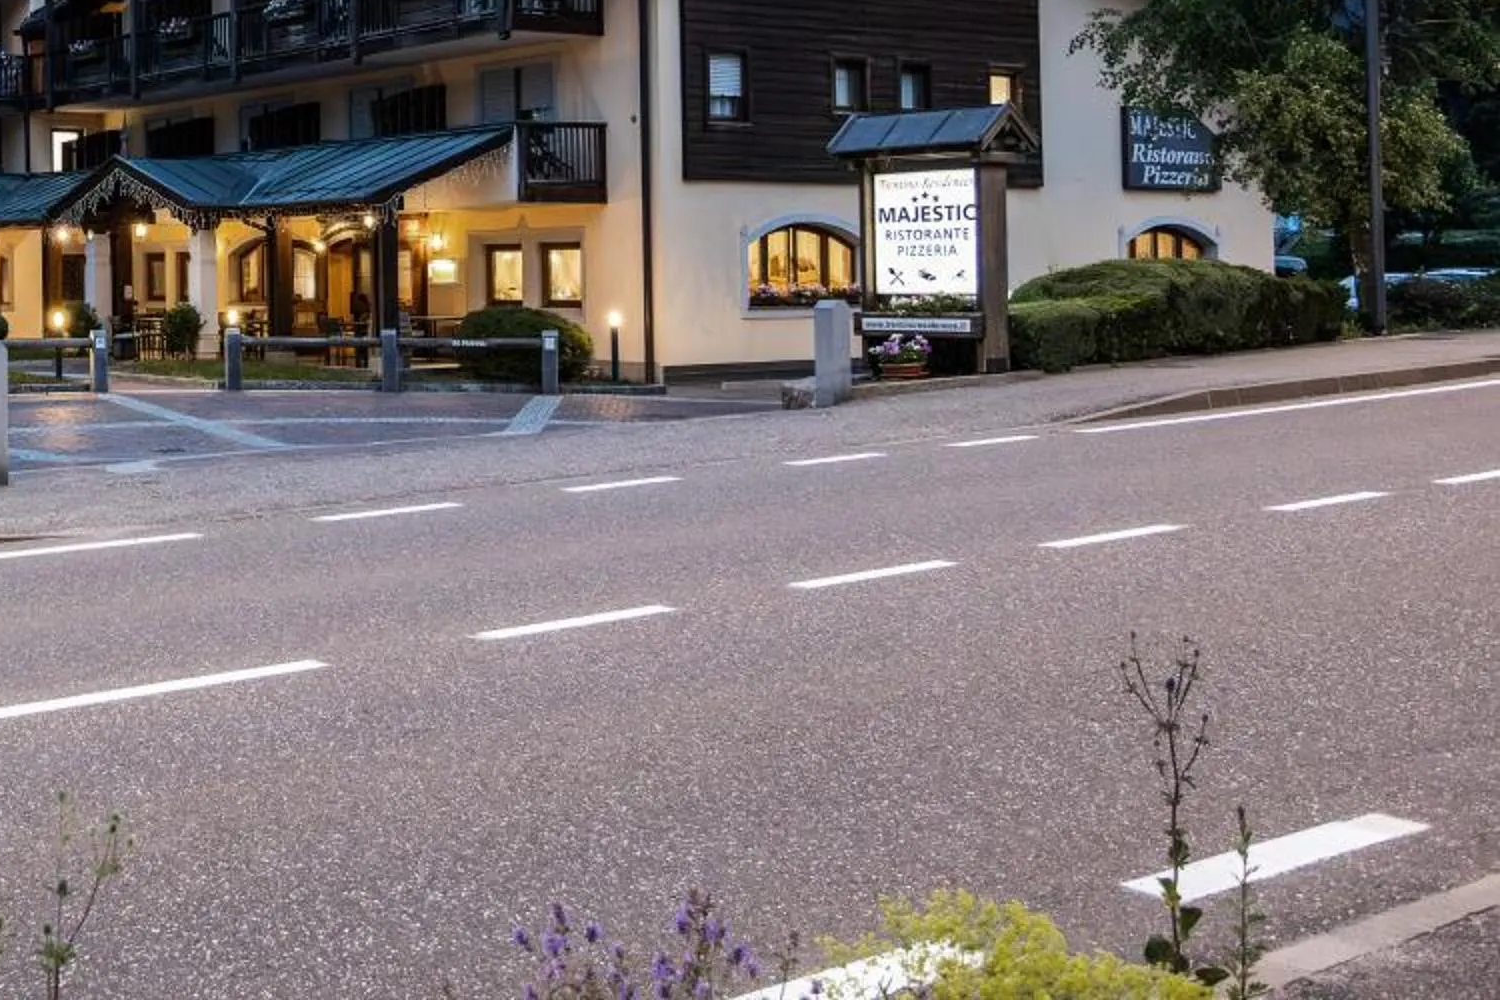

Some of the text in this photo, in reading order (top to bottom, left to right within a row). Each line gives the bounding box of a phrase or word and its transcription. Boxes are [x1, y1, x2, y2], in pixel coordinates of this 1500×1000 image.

[879, 204, 976, 223] MAJESTIC
[885, 228, 969, 241] RISTORANTE
[897, 245, 958, 256] PIZZERIA
